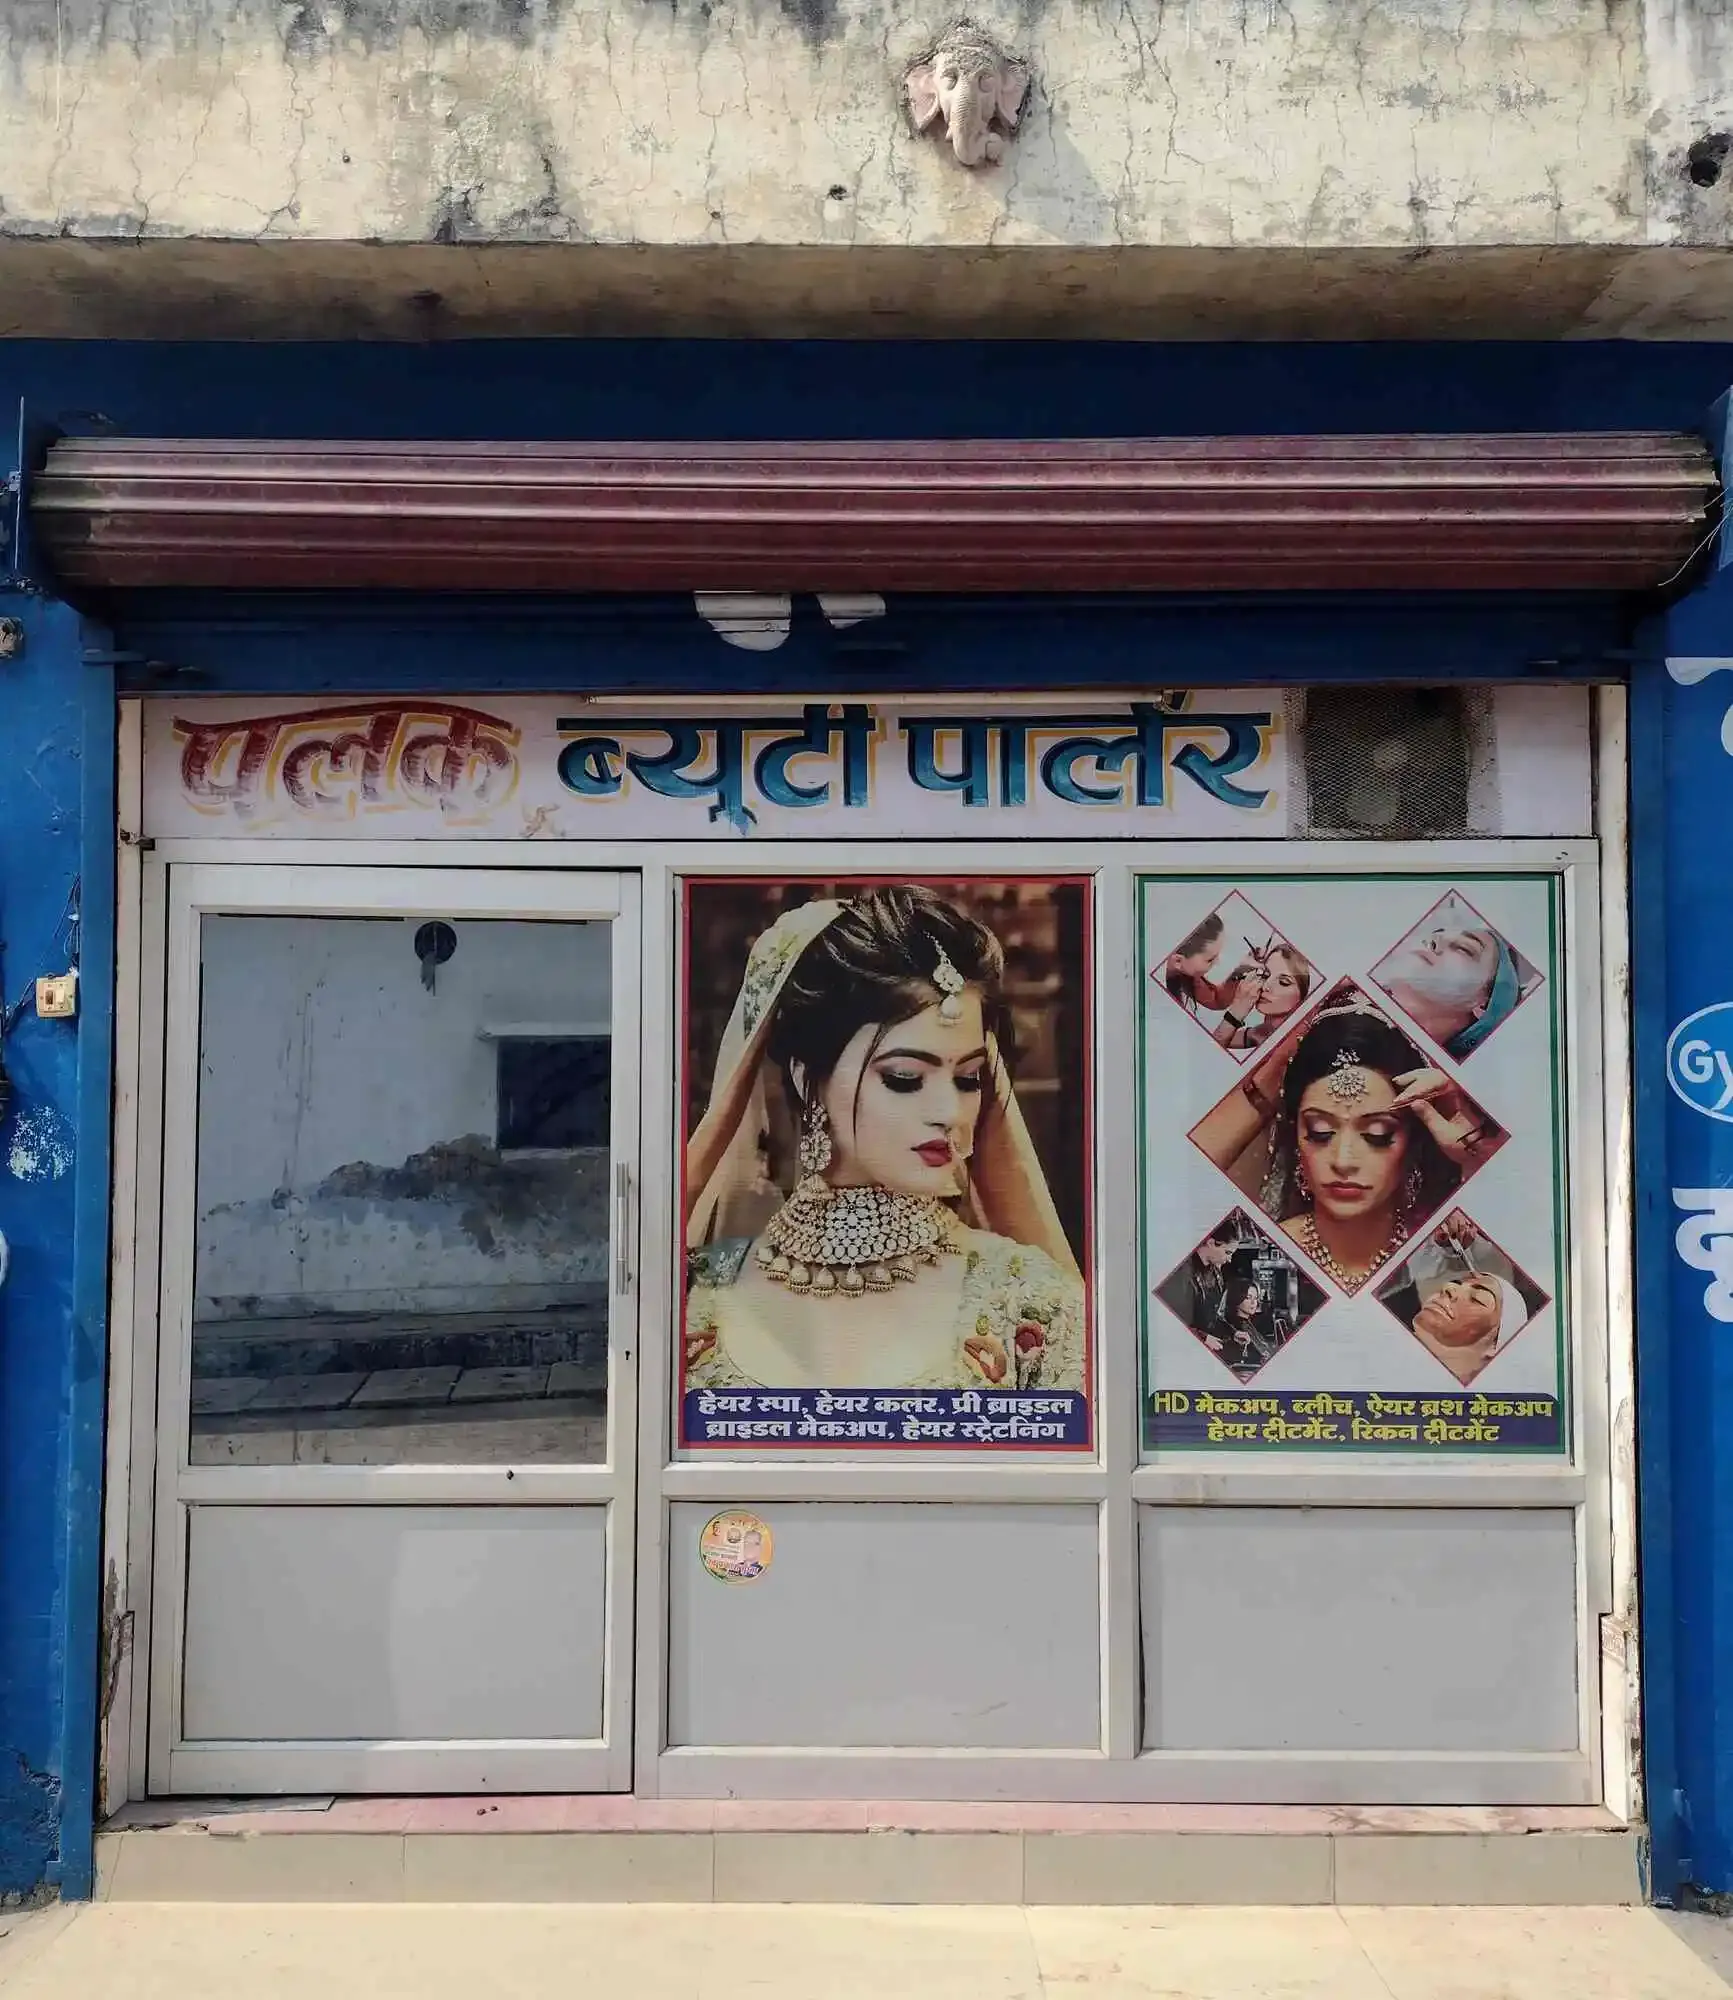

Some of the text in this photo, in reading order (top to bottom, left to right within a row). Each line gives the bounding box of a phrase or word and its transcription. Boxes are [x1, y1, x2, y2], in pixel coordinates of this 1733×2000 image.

[172, 701, 523, 824] पलक
[698, 1390, 1074, 1416] हेयर स्पा, हेयर कलर, प्री ब्राइडल
[1154, 1392, 1554, 1418] HD मेकअप, ब्लीच, ऐयर ब्रश मेकअप
[705, 1414, 1066, 1443] ब्राइडल मेकअप, हेयर स्ट्रेटनिंग
[1207, 1416, 1257, 1441] हेयर
[1423, 1418, 1500, 1445] ट्रीटमेंट
